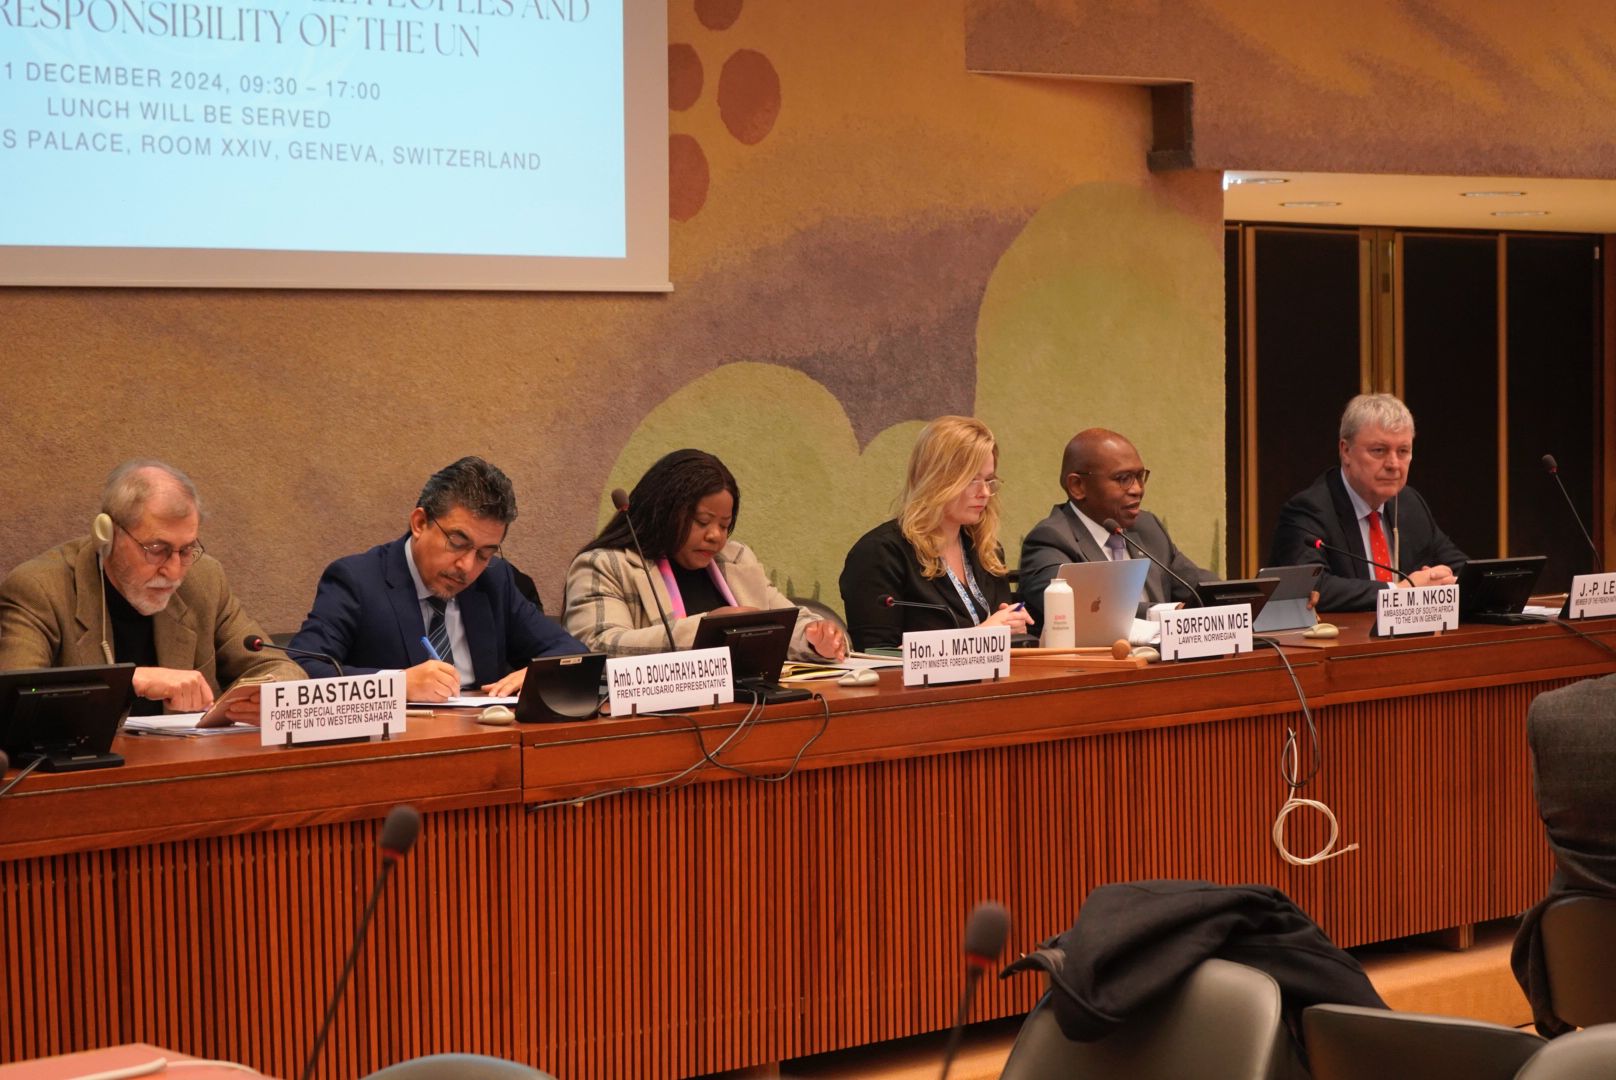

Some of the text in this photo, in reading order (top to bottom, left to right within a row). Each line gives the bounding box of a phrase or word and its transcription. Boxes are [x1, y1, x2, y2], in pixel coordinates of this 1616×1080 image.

[300, 13, 348, 48] OF
[356, 17, 425, 54] THE
[433, 22, 480, 57] UN
[26, 62, 161, 88] DECEMBER
[170, 71, 230, 93] 2024,
[240, 75, 297, 96] 09:30
[326, 80, 381, 100] 17:00
[47, 97, 331, 129] LUNCH WILL BE SERVED
[28, 130, 131, 155] PALACE,
[141, 134, 211, 156] ROOM
[221, 139, 279, 160] XXIV,
[288, 141, 384, 165] GENEVA,
[393, 146, 541, 170] SWITZERLAND
[1382, 588, 1456, 609] H.E. M. NKOSI
[1579, 582, 1600, 597] J.-P.
[1384, 605, 1454, 618] AMBASSADOR OF SOUTH AFRICA
[1395, 617, 1401, 625] TO
[1402, 616, 1411, 624] THE
[1412, 615, 1418, 623] UN
[1425, 614, 1442, 622] GENEVA
[1164, 612, 1249, 636] T. SØRFONN MOE
[909, 635, 1006, 659] Hon. J. MATUNDU
[1204, 632, 1237, 642] NORWEGIAN
[613, 657, 728, 687] Amb. O. BOUCHRAYA BACHIR
[911, 661, 928, 670] DEPUTY
[275, 678, 393, 708] F. BASTAGLI
[617, 678, 726, 699] FRENTE POLISARIO REPRESENTATIVE
[270, 700, 397, 721] FORMER SPECIAL REPRESENTATIVE
[275, 711, 393, 731] OF THE UN TO WESTERN SAHARA
